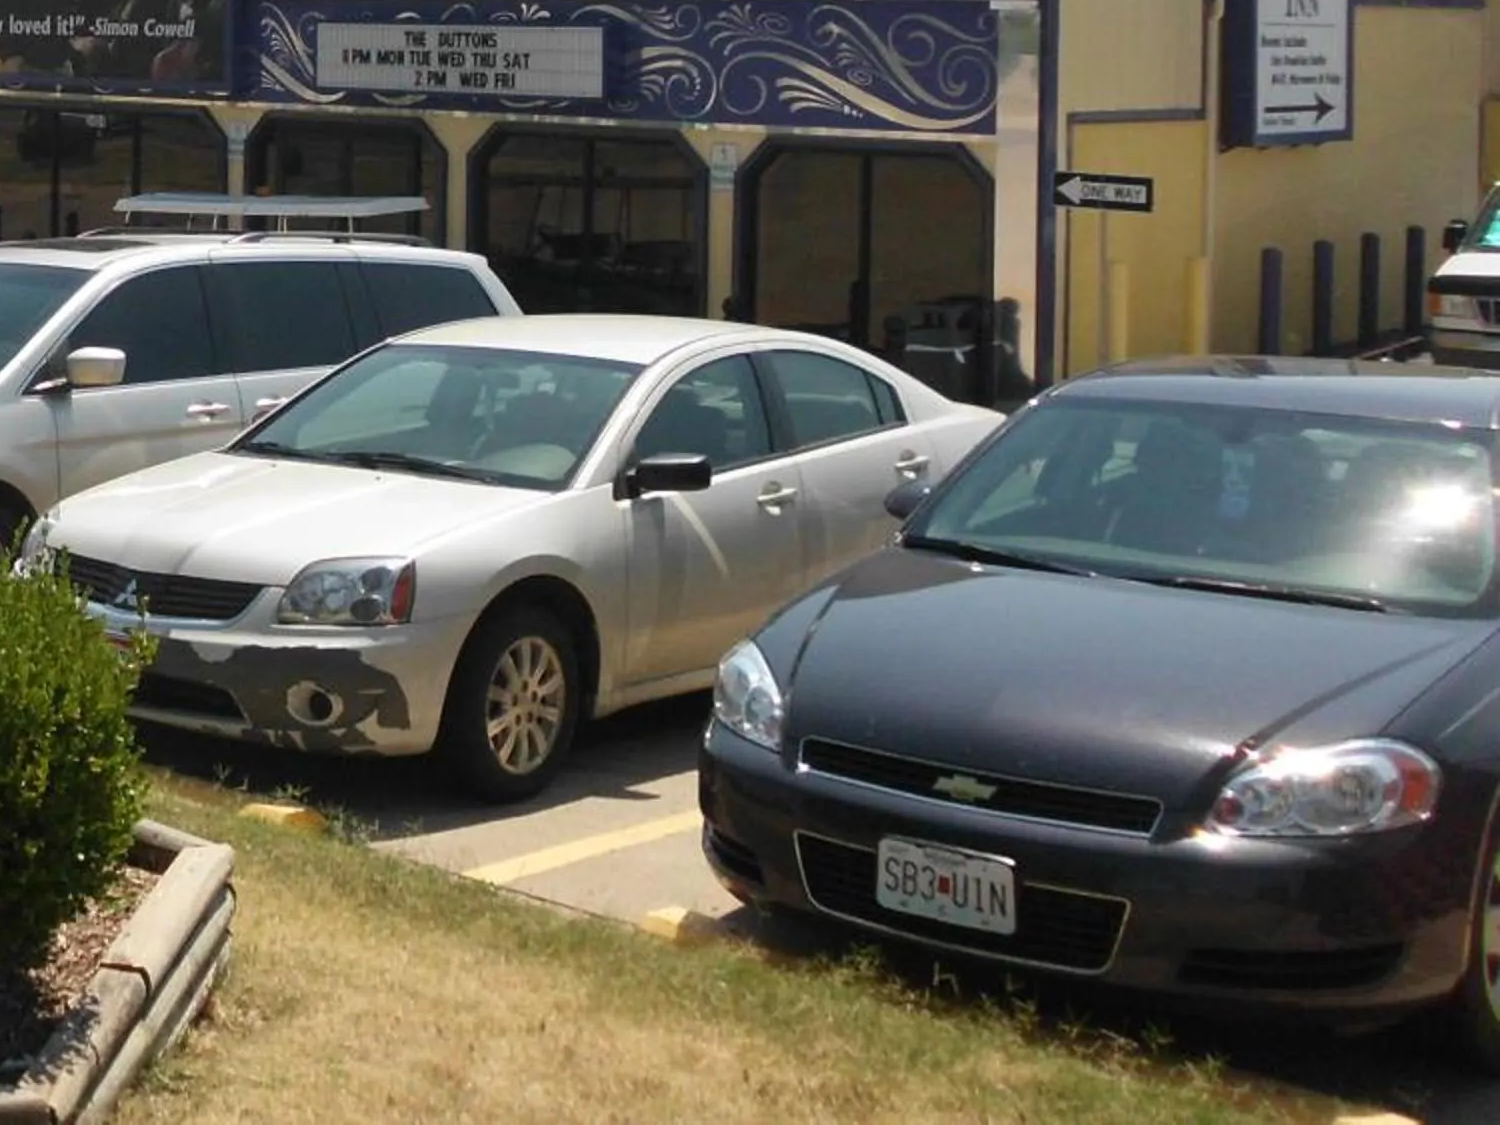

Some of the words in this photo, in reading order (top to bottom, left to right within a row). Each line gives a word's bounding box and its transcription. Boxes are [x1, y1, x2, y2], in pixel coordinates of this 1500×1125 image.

[9, 15, 51, 36] loved
[144, 18, 195, 38] Cowell
[404, 31, 426, 47] THE
[438, 32, 497, 48] DUTTONS
[351, 52, 371, 65] PM
[377, 52, 404, 65] MON
[410, 52, 430, 67] TUE
[437, 53, 464, 68] WED
[472, 53, 496, 68] THU
[503, 53, 530, 69] SAT
[427, 72, 446, 87] PM
[460, 73, 488, 88] WED
[494, 74, 515, 88] FRI
[1081, 184, 1107, 199] ONE
[1113, 187, 1143, 200] WAY
